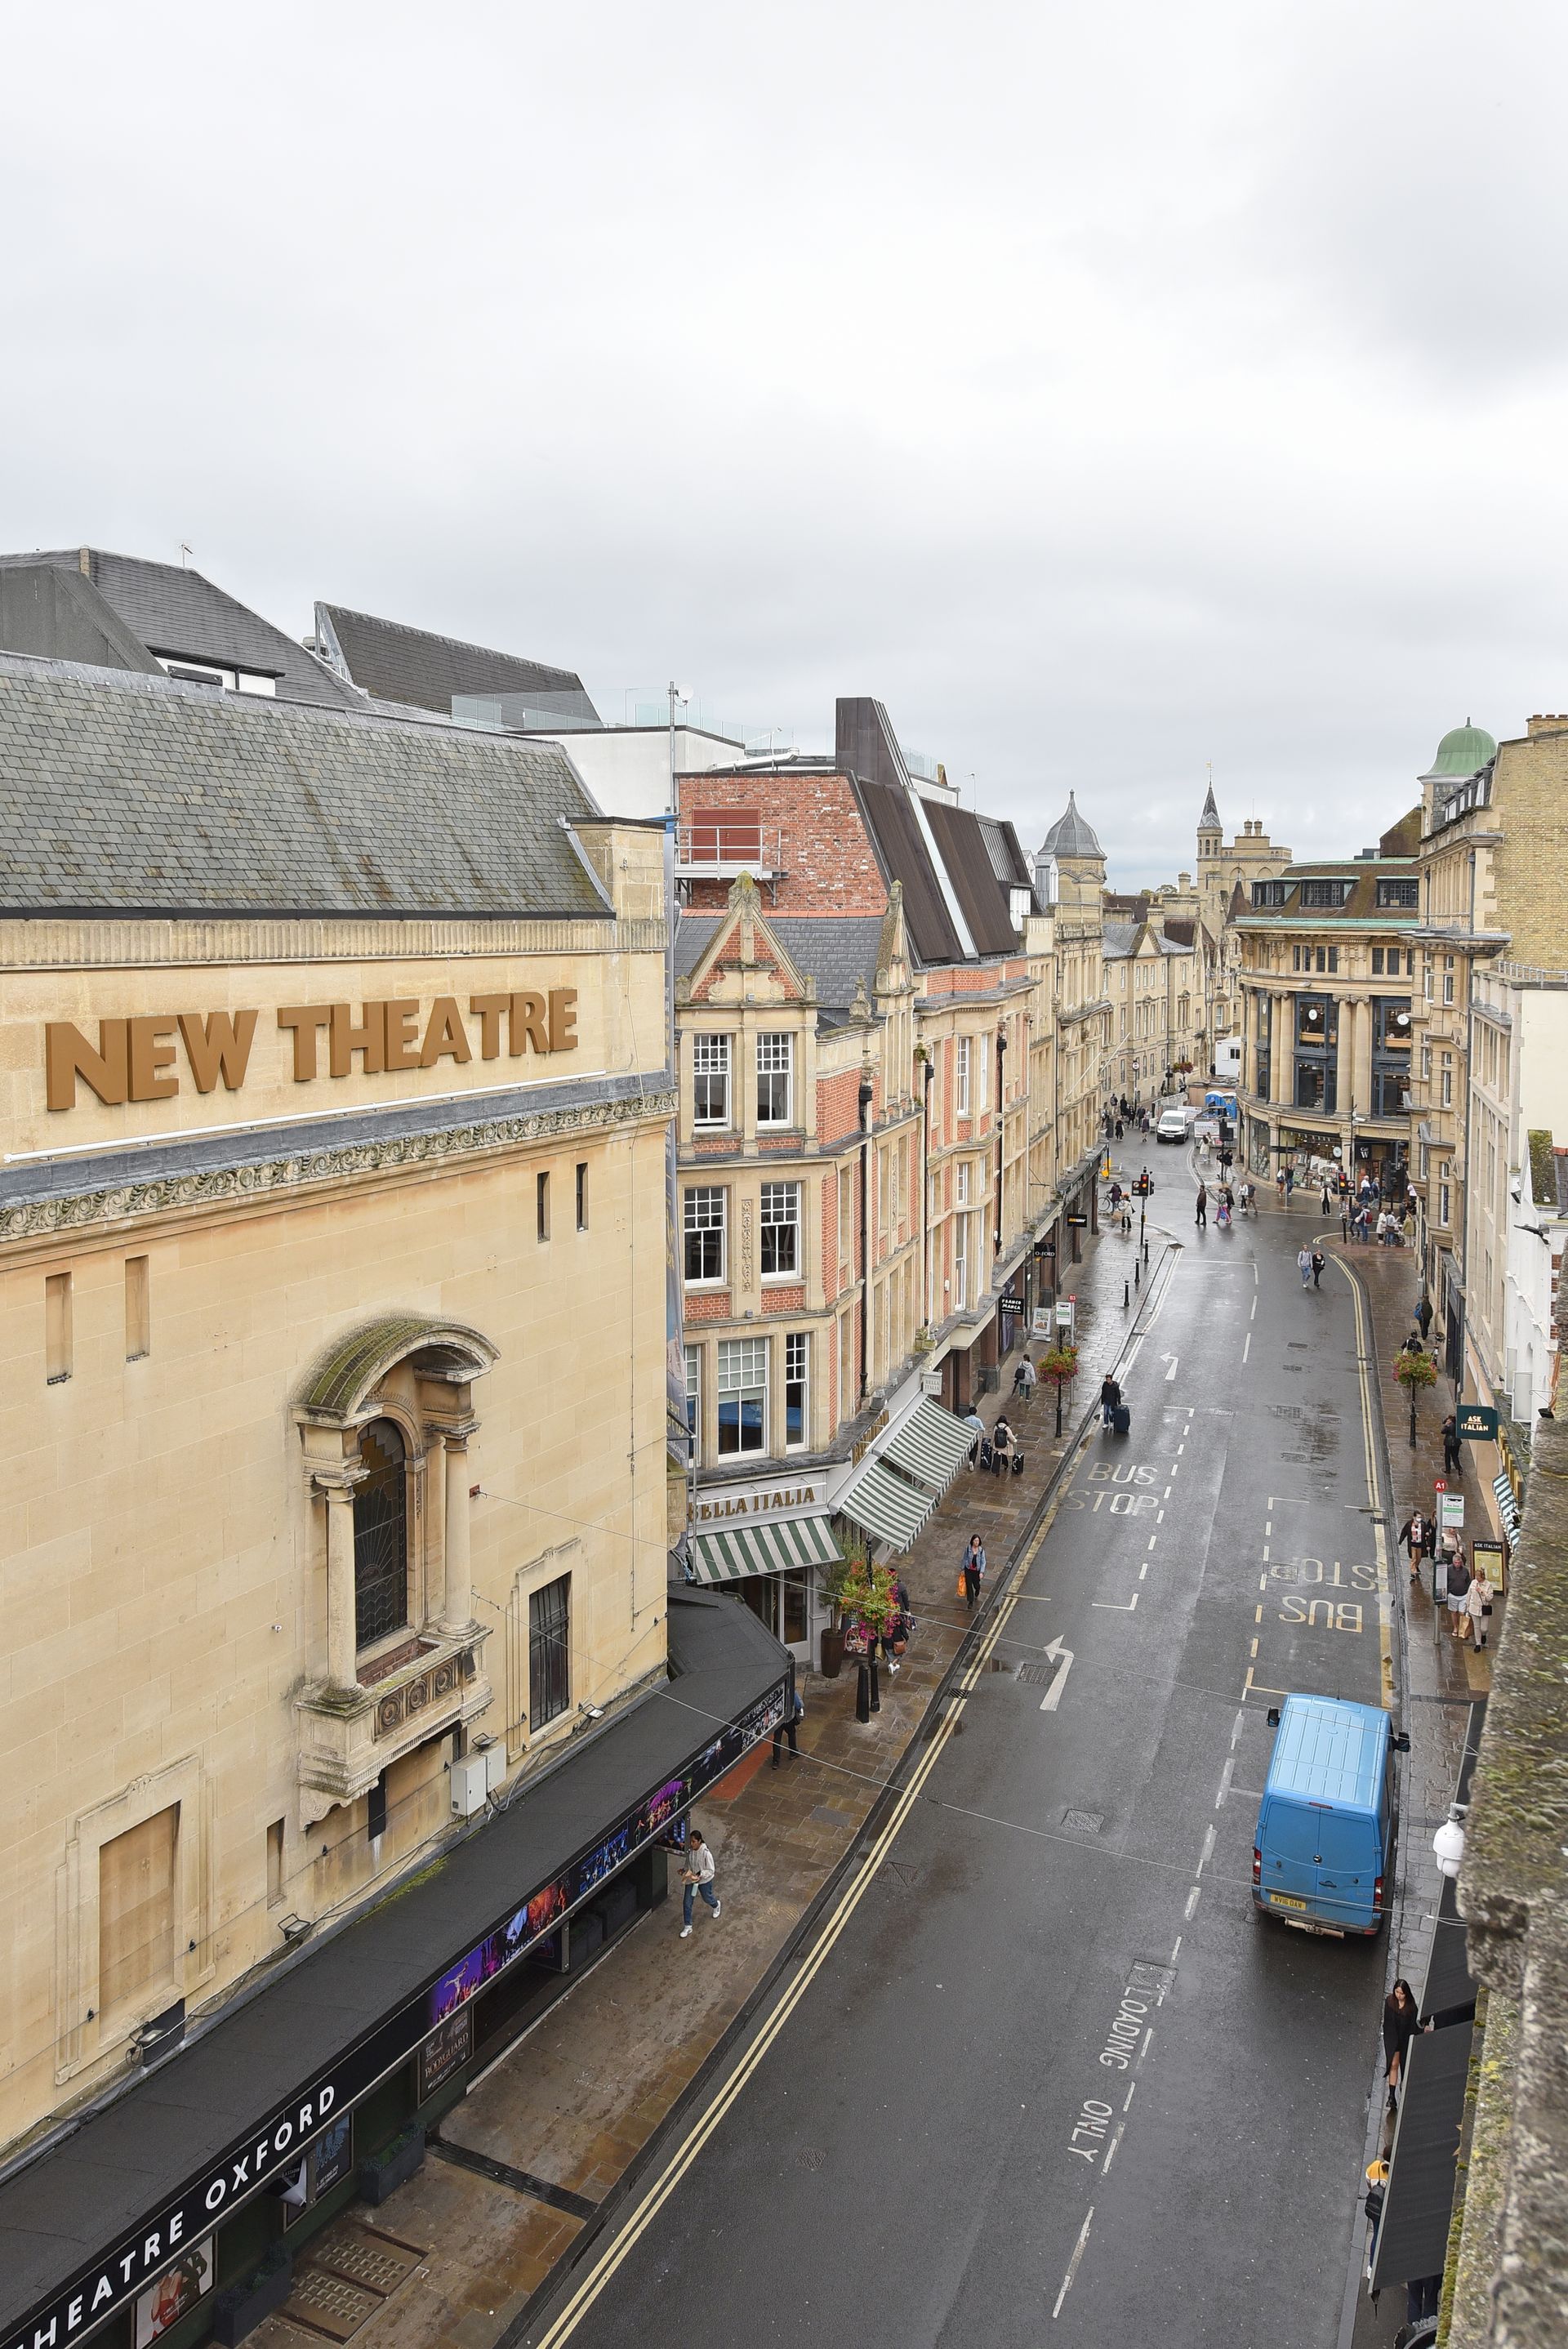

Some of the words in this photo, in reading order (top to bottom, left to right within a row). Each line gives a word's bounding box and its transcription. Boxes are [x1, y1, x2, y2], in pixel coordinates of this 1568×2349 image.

[45, 1010, 258, 1111] NEW
[278, 989, 579, 1081] THEATRE
[1460, 1423, 1489, 1432] ITALIAN
[1087, 1462, 1158, 1485] BUS
[752, 1484, 816, 1512] ITALIA
[1064, 1489, 1160, 1516] STOP
[1278, 1595, 1363, 1634] BUS
[1098, 1986, 1152, 2070] LOADING
[425, 2032, 469, 2078] BODYGUARD
[1067, 2099, 1113, 2163] ONLY
[15, 2210, 184, 2349] HEATRE
[204, 2085, 336, 2210] OXFORD
